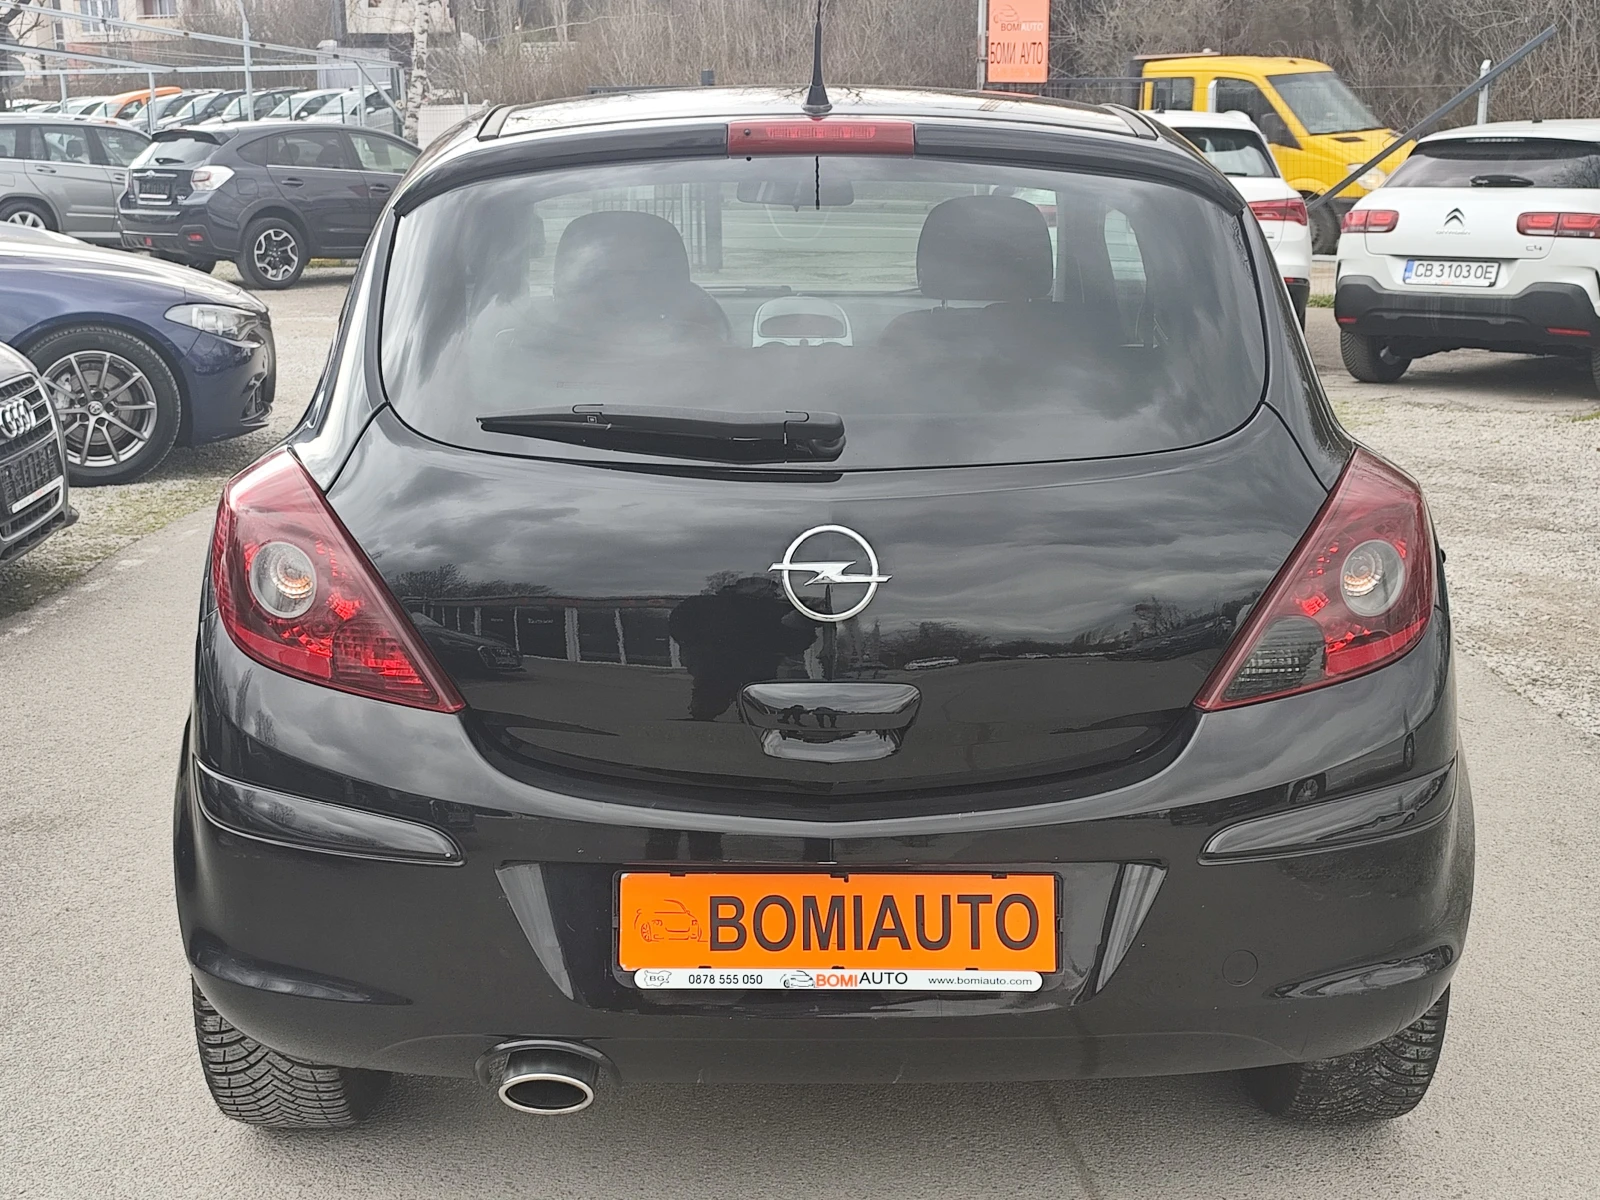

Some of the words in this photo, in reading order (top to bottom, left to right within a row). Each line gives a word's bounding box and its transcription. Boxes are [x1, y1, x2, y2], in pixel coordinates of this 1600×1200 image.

[990, 42, 1016, 64] БОМИ
[1020, 42, 1044, 64] АУТО
[1415, 263, 1434, 277] CB
[1435, 264, 1472, 279] 3103
[1474, 265, 1495, 280] OE
[709, 894, 1040, 952] BOMIAUTO
[688, 974, 715, 984] 0878
[719, 974, 739, 984] 555
[742, 974, 763, 984] 050
[815, 971, 908, 988] BOMIAUTO
[928, 976, 1033, 986] www.bomiauto.com
